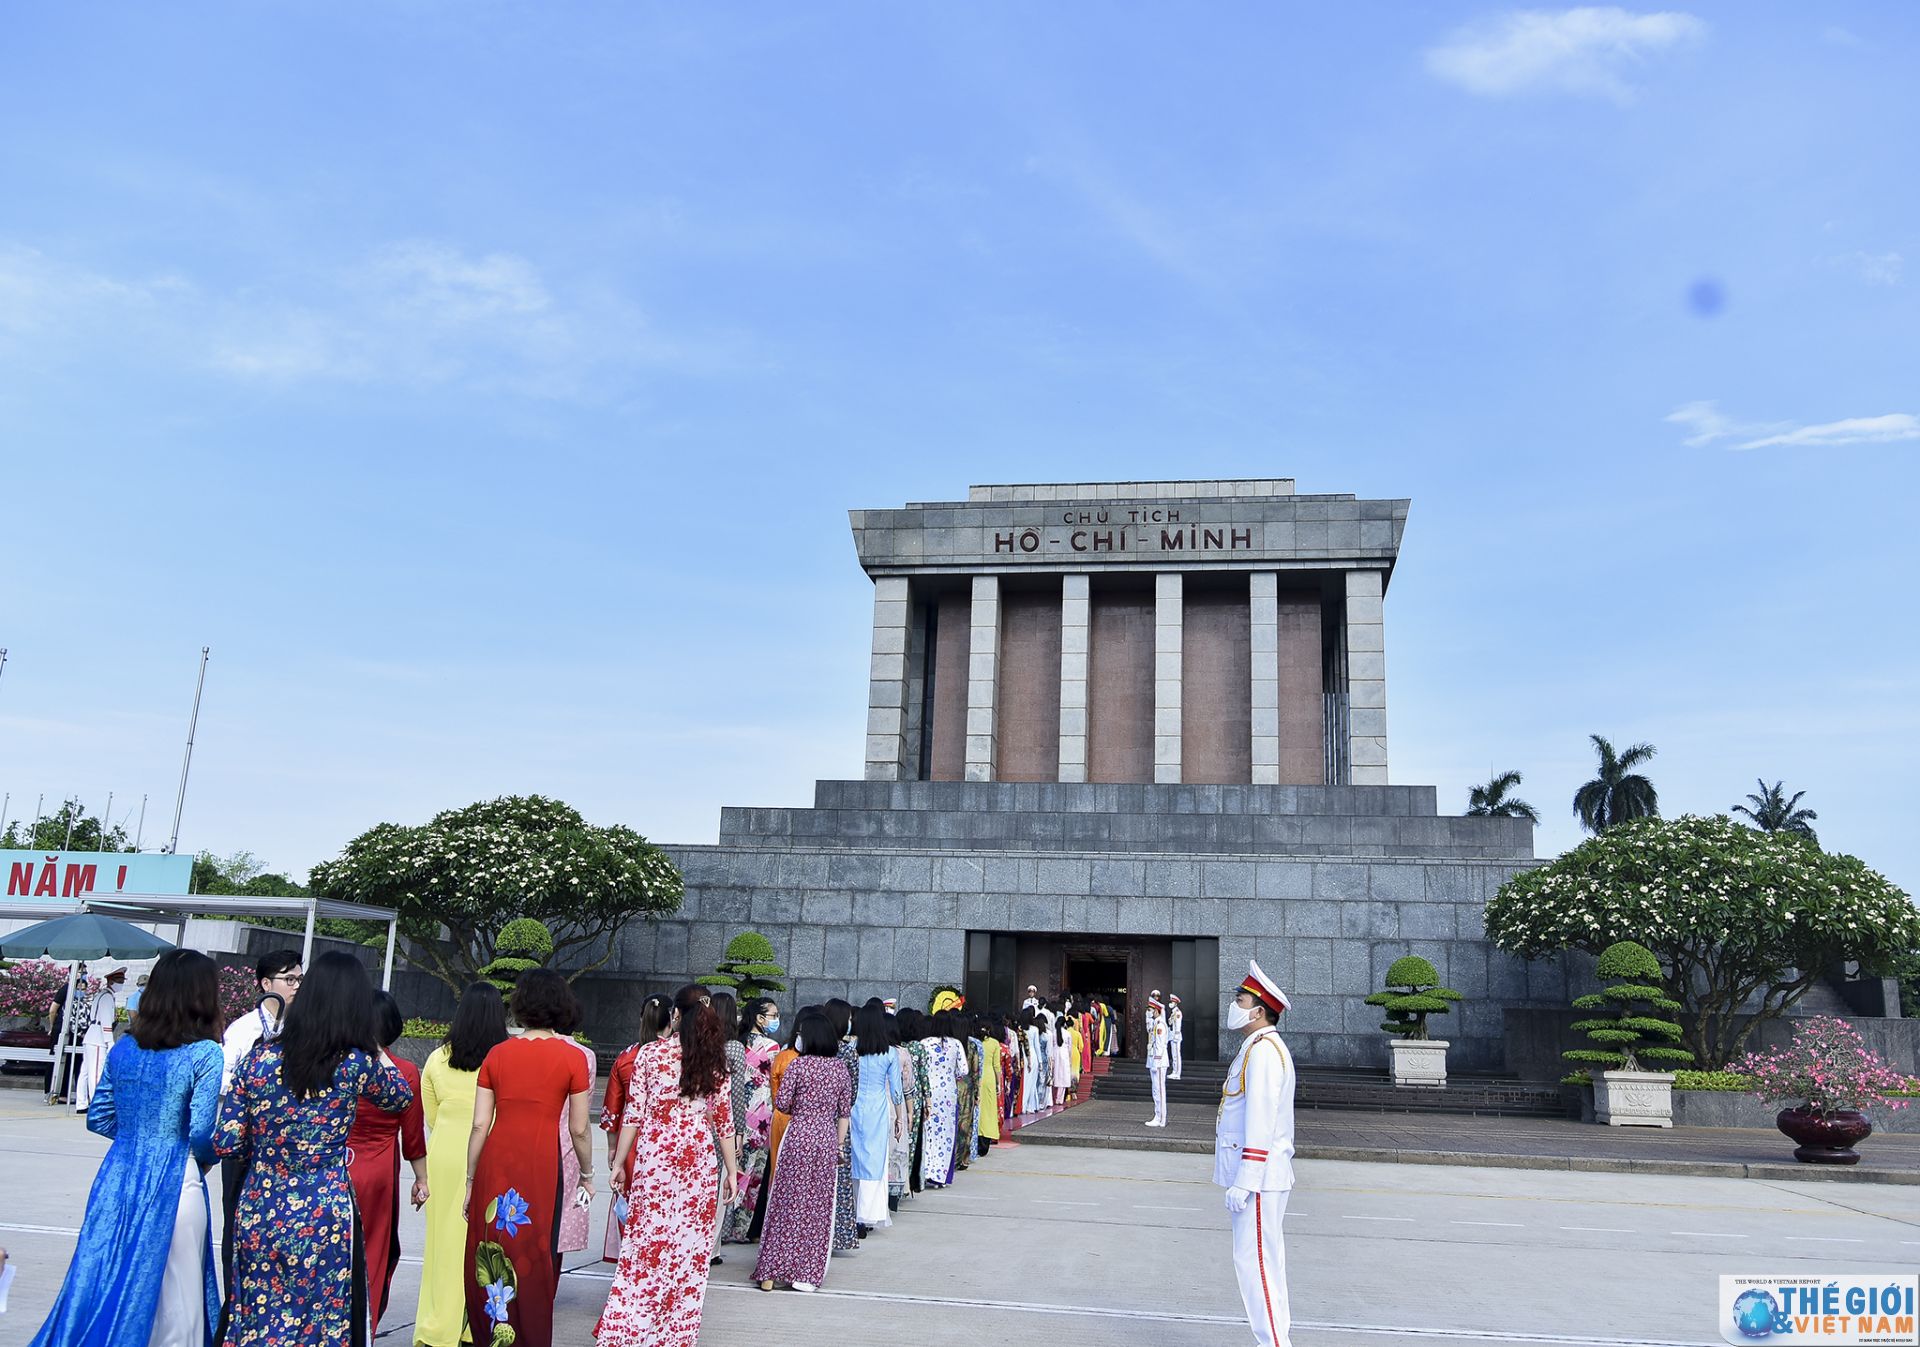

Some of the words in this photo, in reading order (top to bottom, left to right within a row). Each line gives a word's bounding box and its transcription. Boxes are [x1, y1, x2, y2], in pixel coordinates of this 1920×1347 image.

[995, 527, 1041, 553] HỒ
[1070, 525, 1127, 552] CHÍ
[1160, 522, 1251, 551] MINH
[7, 855, 97, 898] NĂM
